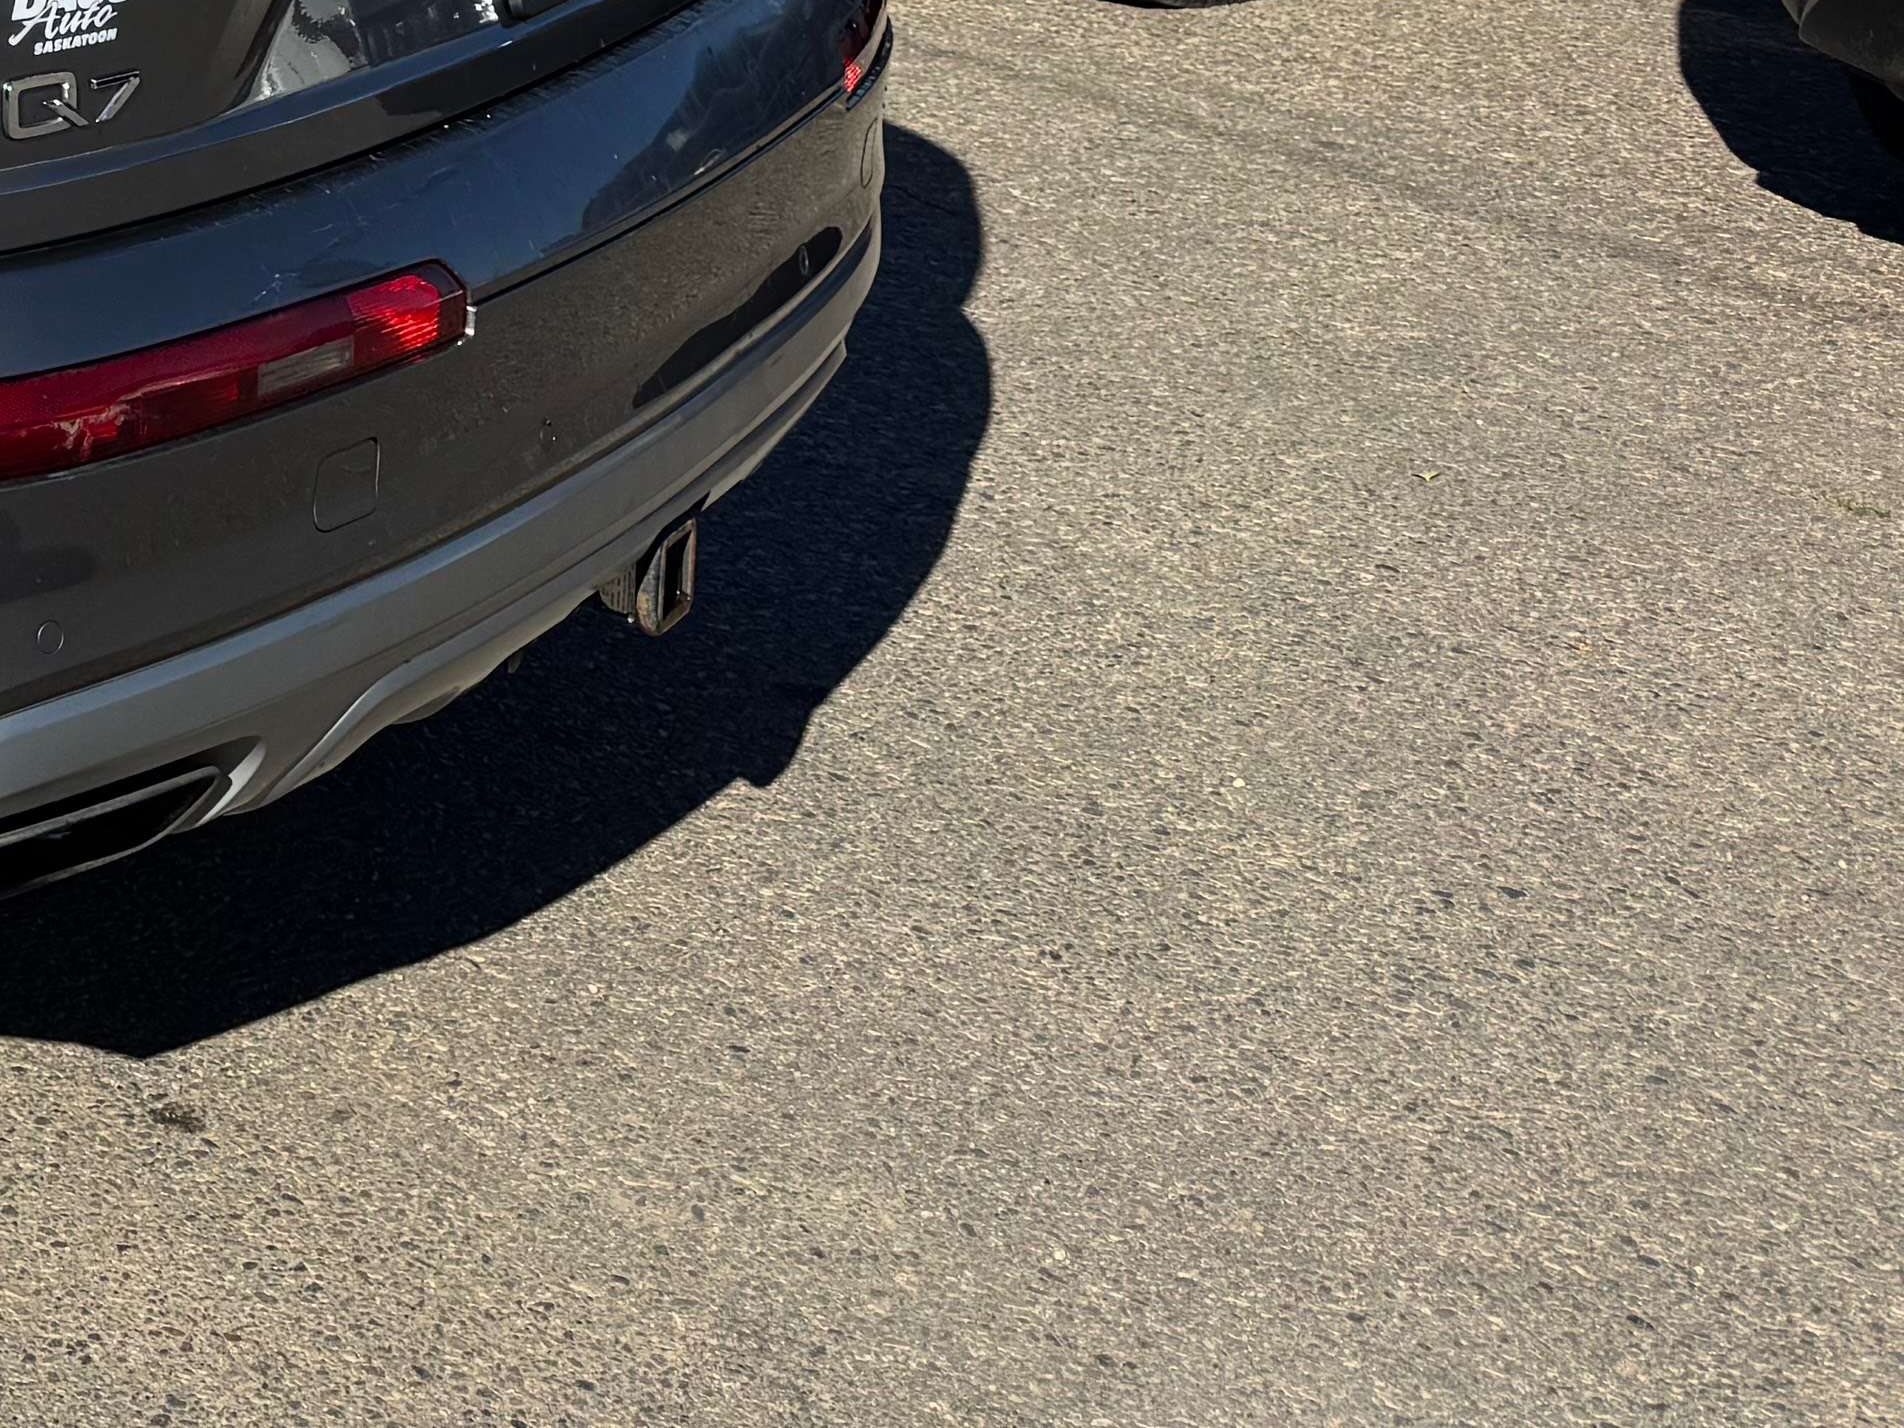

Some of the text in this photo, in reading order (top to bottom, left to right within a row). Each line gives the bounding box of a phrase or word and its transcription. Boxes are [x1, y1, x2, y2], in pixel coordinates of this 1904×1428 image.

[7, 0, 119, 47] Auto
[33, 27, 119, 56] SASKATOON
[1, 70, 142, 140] Q7
